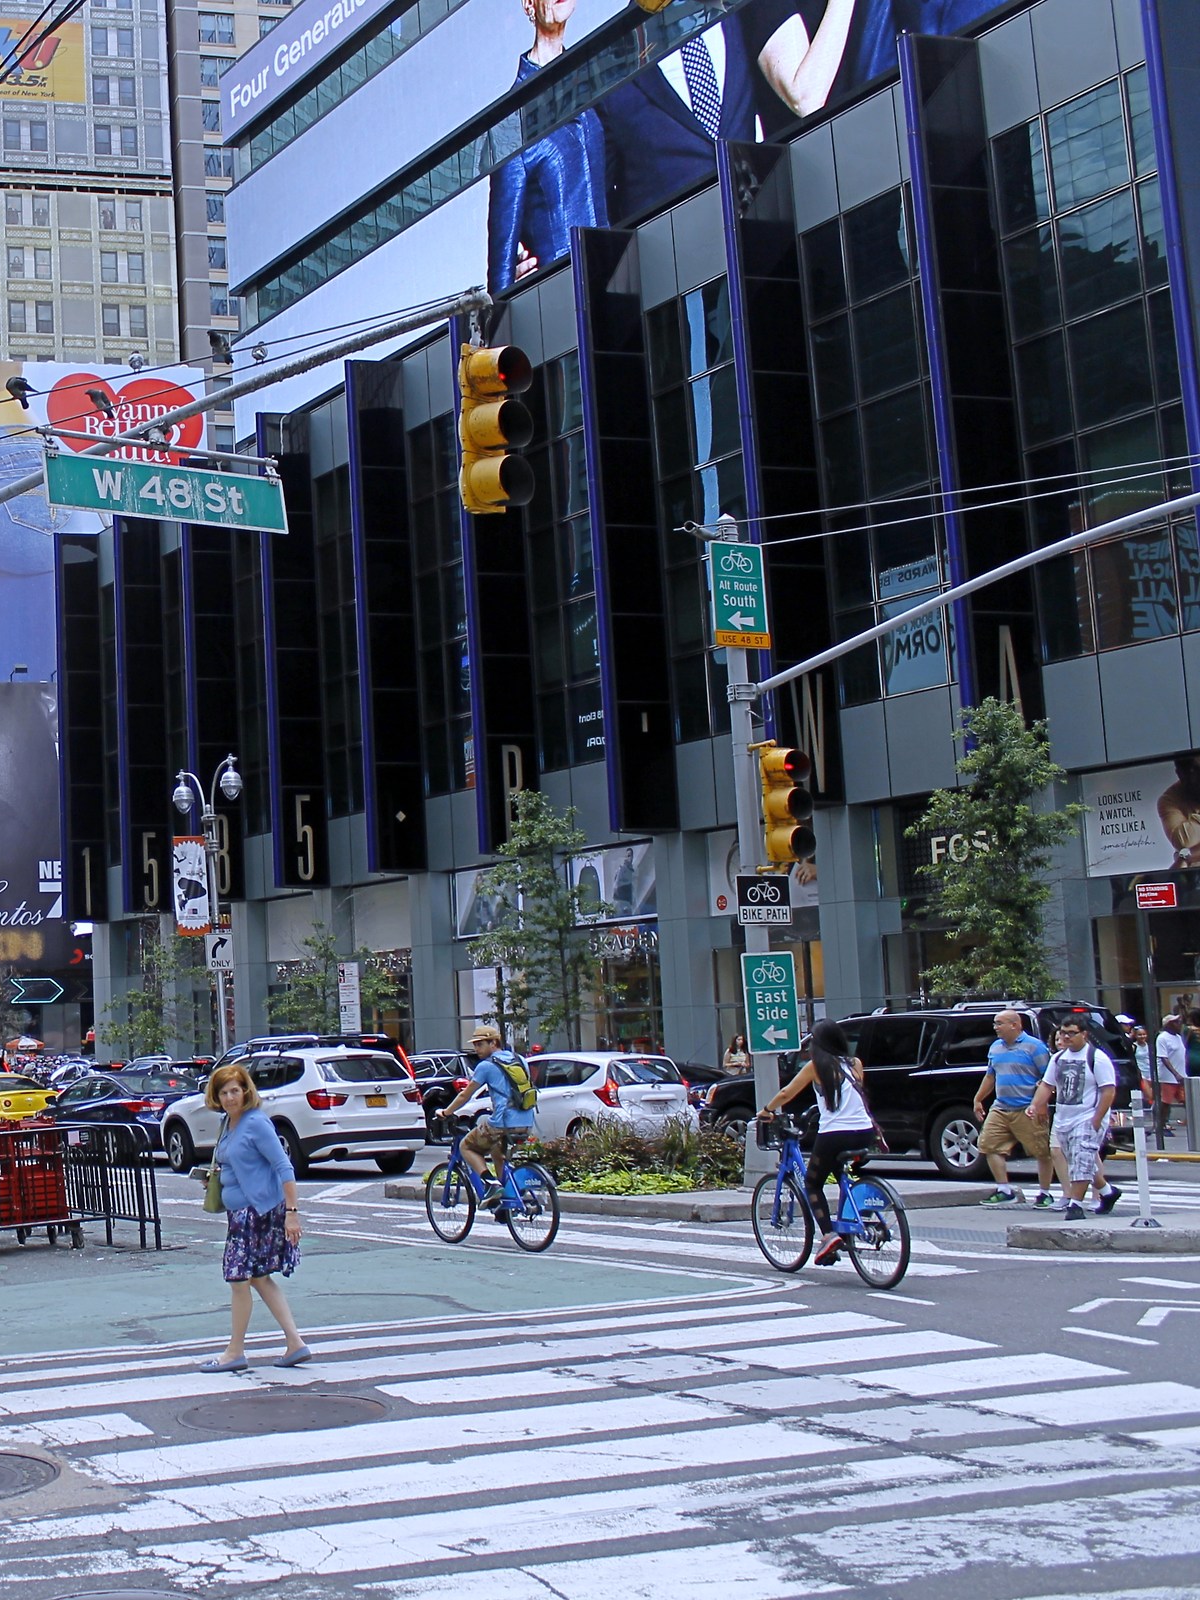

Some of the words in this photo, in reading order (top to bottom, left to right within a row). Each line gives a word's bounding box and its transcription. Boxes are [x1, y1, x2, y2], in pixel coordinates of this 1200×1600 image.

[230, 65, 270, 118] Four
[92, 468, 123, 501] W
[139, 475, 193, 509] 48
[204, 482, 244, 516] St
[719, 580, 730, 590] Alt
[734, 582, 758, 592] Route
[723, 594, 756, 608] South
[722, 635, 737, 644] USE
[740, 636, 751, 644] 48
[755, 637, 764, 645] ST
[1098, 793, 1123, 806] LOOKS
[1125, 791, 1142, 803] LIKE
[1099, 811, 1105, 821] A
[1106, 807, 1135, 820] WATCH,
[1100, 823, 1120, 836] ACTS
[1122, 821, 1138, 834] LIKE
[1140, 820, 1146, 831] A
[742, 908, 763, 920] BIKE
[767, 908, 788, 920] PATH
[755, 990, 787, 1004] East
[757, 1006, 788, 1021] Side
